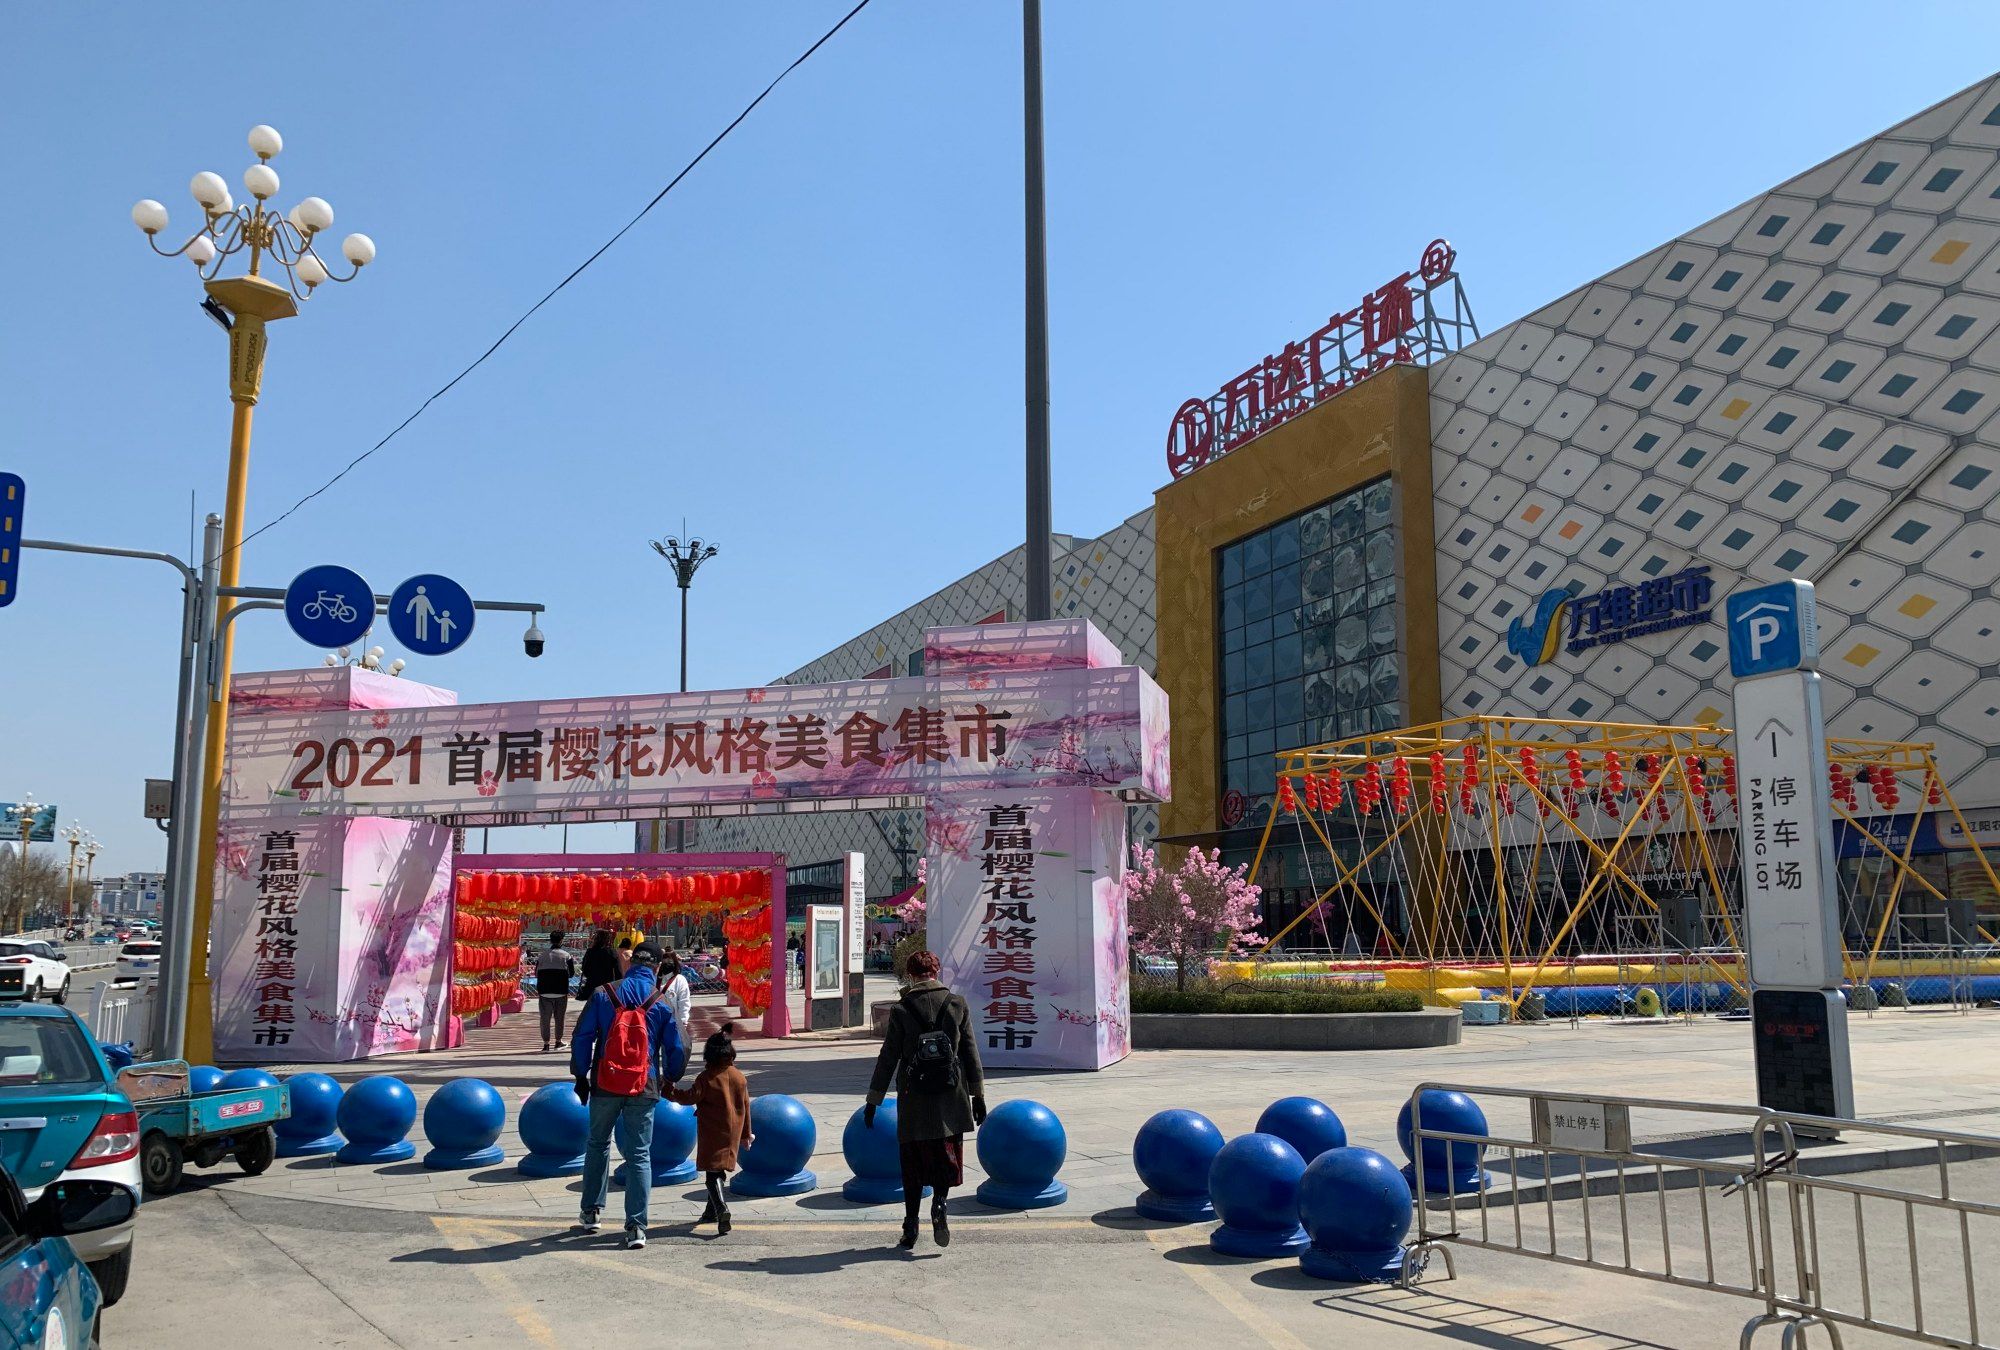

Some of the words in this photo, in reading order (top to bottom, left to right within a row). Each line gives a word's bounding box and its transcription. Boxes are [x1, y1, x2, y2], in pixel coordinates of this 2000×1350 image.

[1220, 271, 1414, 433] 万达广场
[1567, 566, 1711, 639] 万维超市
[1750, 615, 1780, 661] P
[291, 735, 424, 791] 2021
[442, 703, 1012, 787] 首届樱花风格美食集市
[1750, 778, 1767, 856] PARKING
[1770, 776, 1802, 890] 停车场
[1621, 873, 1669, 882] ARBUCKS
[1670, 871, 1702, 880] COFEE
[1756, 863, 1770, 891] LOT
[252, 830, 301, 1047] 首届樱花风格美食集市
[980, 803, 1039, 1051] 首届樱花风格美食集市
[1554, 1114, 1600, 1131] 禁止停车
